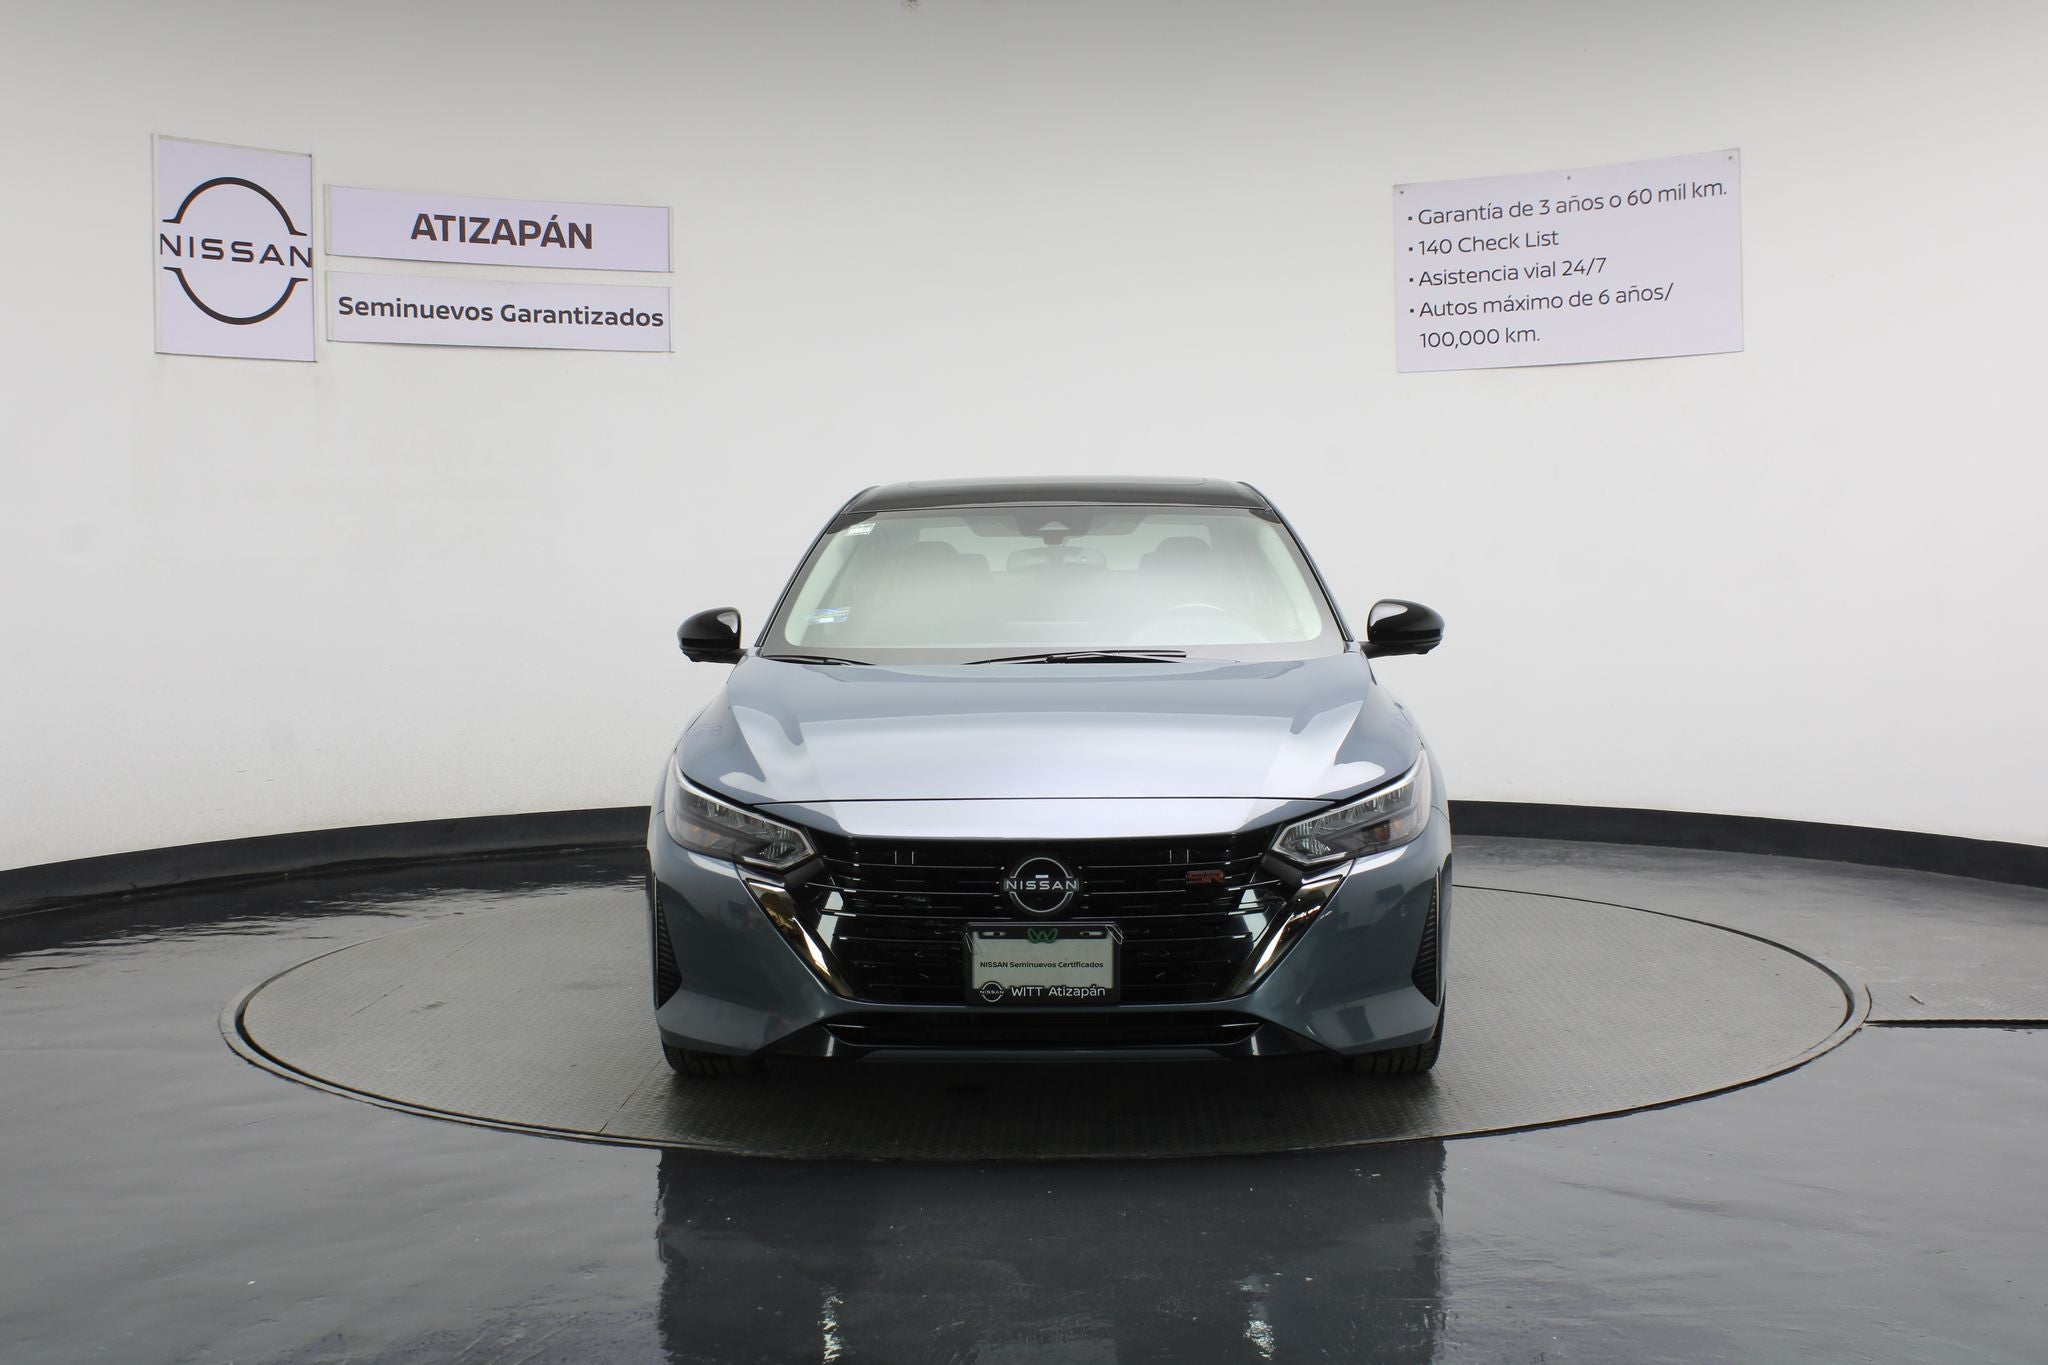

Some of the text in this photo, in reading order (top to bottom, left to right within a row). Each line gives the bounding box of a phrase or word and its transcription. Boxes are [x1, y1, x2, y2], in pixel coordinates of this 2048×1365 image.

[1418, 179, 1727, 225] Garantía de 3 años o 60 mil km.
[410, 213, 594, 250] ATIZAPÁN
[1418, 229, 1559, 255] 140 Check List
[160, 233, 313, 268] NISSAN
[1419, 256, 1607, 287] Asistencia vial 24/7
[338, 295, 664, 328] Seminuevos Garantizados
[1419, 282, 1674, 318] Autos máximo de 6 años/
[1419, 326, 1541, 350] 100,000 km.
[1004, 879, 1078, 891] NISSAN
[1011, 984, 1106, 999] WITT Atizapán
